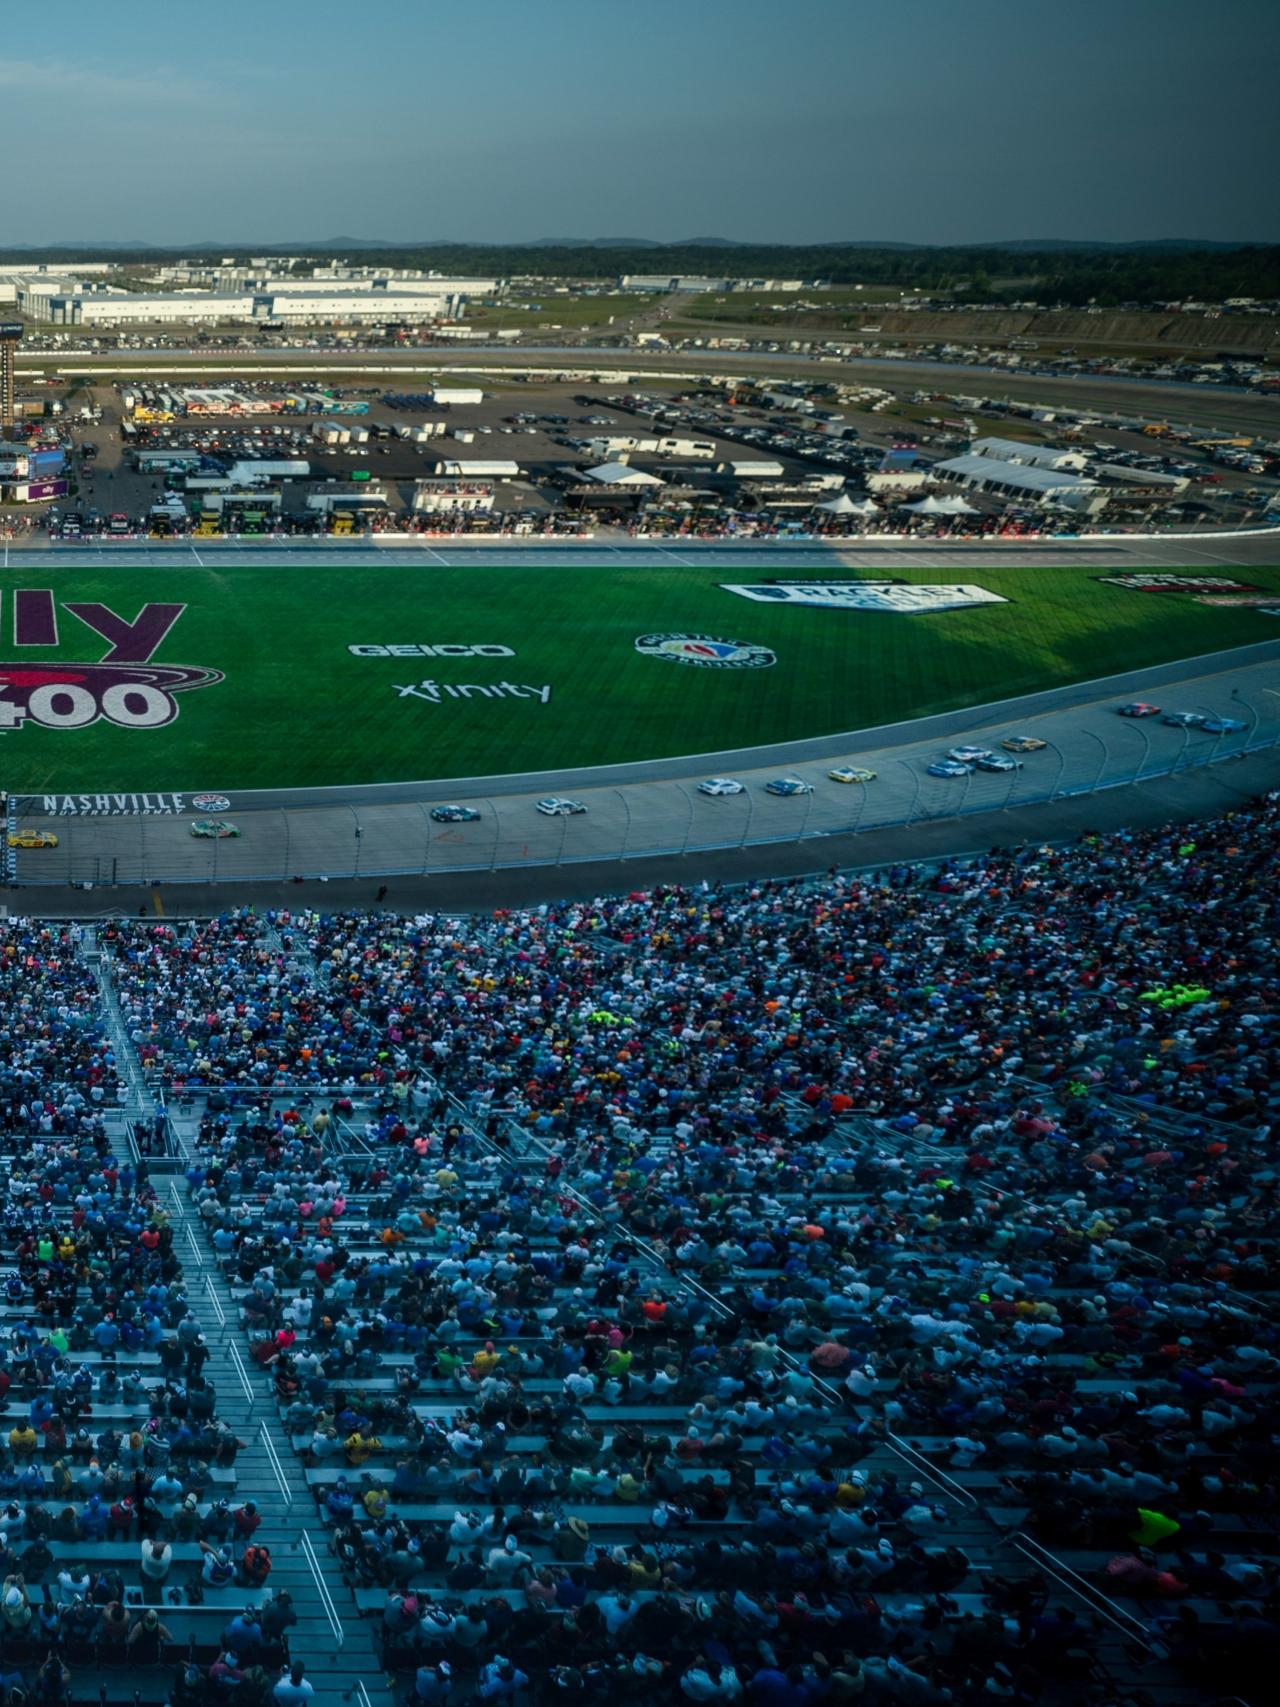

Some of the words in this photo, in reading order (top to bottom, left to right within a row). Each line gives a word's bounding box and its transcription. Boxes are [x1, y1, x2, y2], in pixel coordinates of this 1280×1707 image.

[794, 587, 975, 598] RACKLEY
[348, 644, 516, 657] GEICO
[391, 679, 551, 703] xfinity
[43, 793, 186, 810] NASHVILLE
[48, 808, 184, 816] SUPERSPEEDWAY
